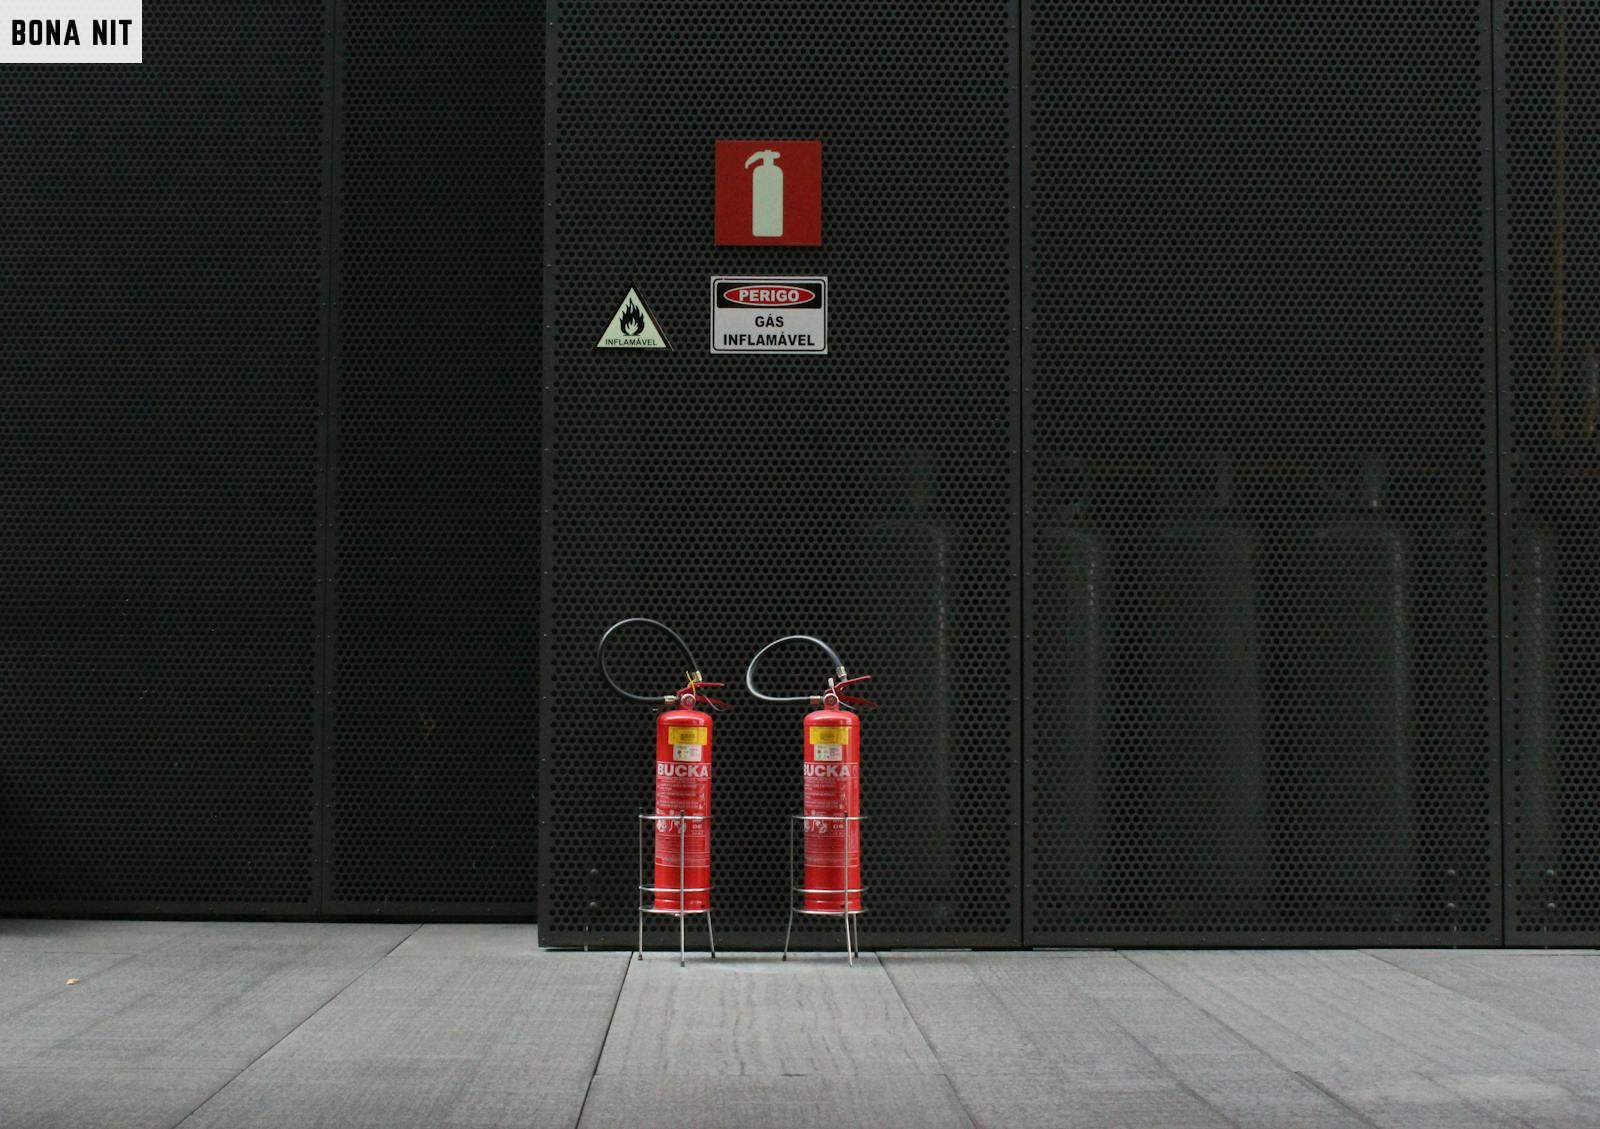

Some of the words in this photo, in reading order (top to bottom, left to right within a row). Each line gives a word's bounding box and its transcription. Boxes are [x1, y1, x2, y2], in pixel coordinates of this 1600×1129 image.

[738, 288, 801, 303] PERIGO
[754, 313, 784, 328] GÁS
[605, 337, 657, 346] INFLAMÁVEL
[723, 331, 815, 346] INFLAMÁVEL
[657, 763, 708, 777] BUCKA
